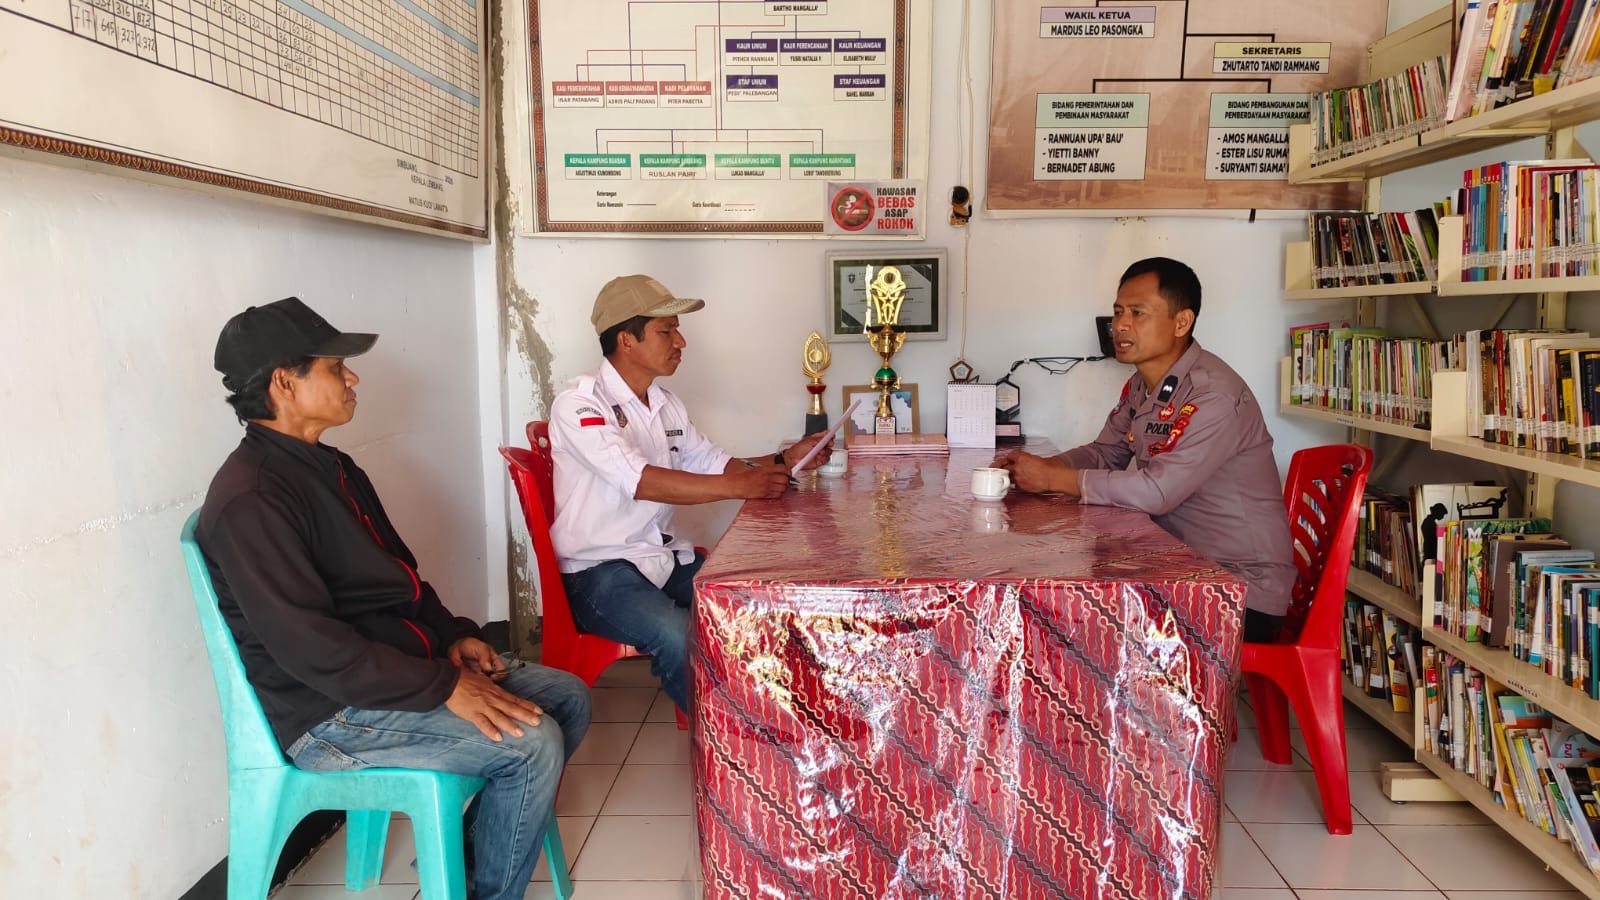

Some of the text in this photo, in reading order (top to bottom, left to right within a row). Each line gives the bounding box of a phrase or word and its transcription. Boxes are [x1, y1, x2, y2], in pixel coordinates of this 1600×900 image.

[1064, 11, 1131, 20] WAKIL KETUA
[1051, 24, 1144, 36] MARDUS LEO PASONGKA
[1242, 47, 1302, 55] SEKRETARIS
[1222, 60, 1320, 72] ZHUTARTO TANDI RAMMANG
[1228, 101, 1309, 109] BIDANG PEMBANGUNAN DAN
[1048, 133, 1124, 144] RANNUAN UPA' BAU'
[1222, 133, 1245, 144] AMOS
[1048, 148, 1100, 158] YIETTI BANNY
[1222, 148, 1245, 158] ESTER
[1247, 148, 1264, 158] LISU
[1047, 163, 1115, 173] BERNADET ABUNG
[1220, 163, 1257, 173] SURYANTI
[1259, 163, 1286, 173] SIAMA'
[877, 187, 916, 196] KAWASAN
[878, 197, 914, 208] BEBAS
[885, 208, 908, 217] ASAP
[877, 219, 914, 230] ROKOK
[1145, 422, 1174, 435] POLRI
